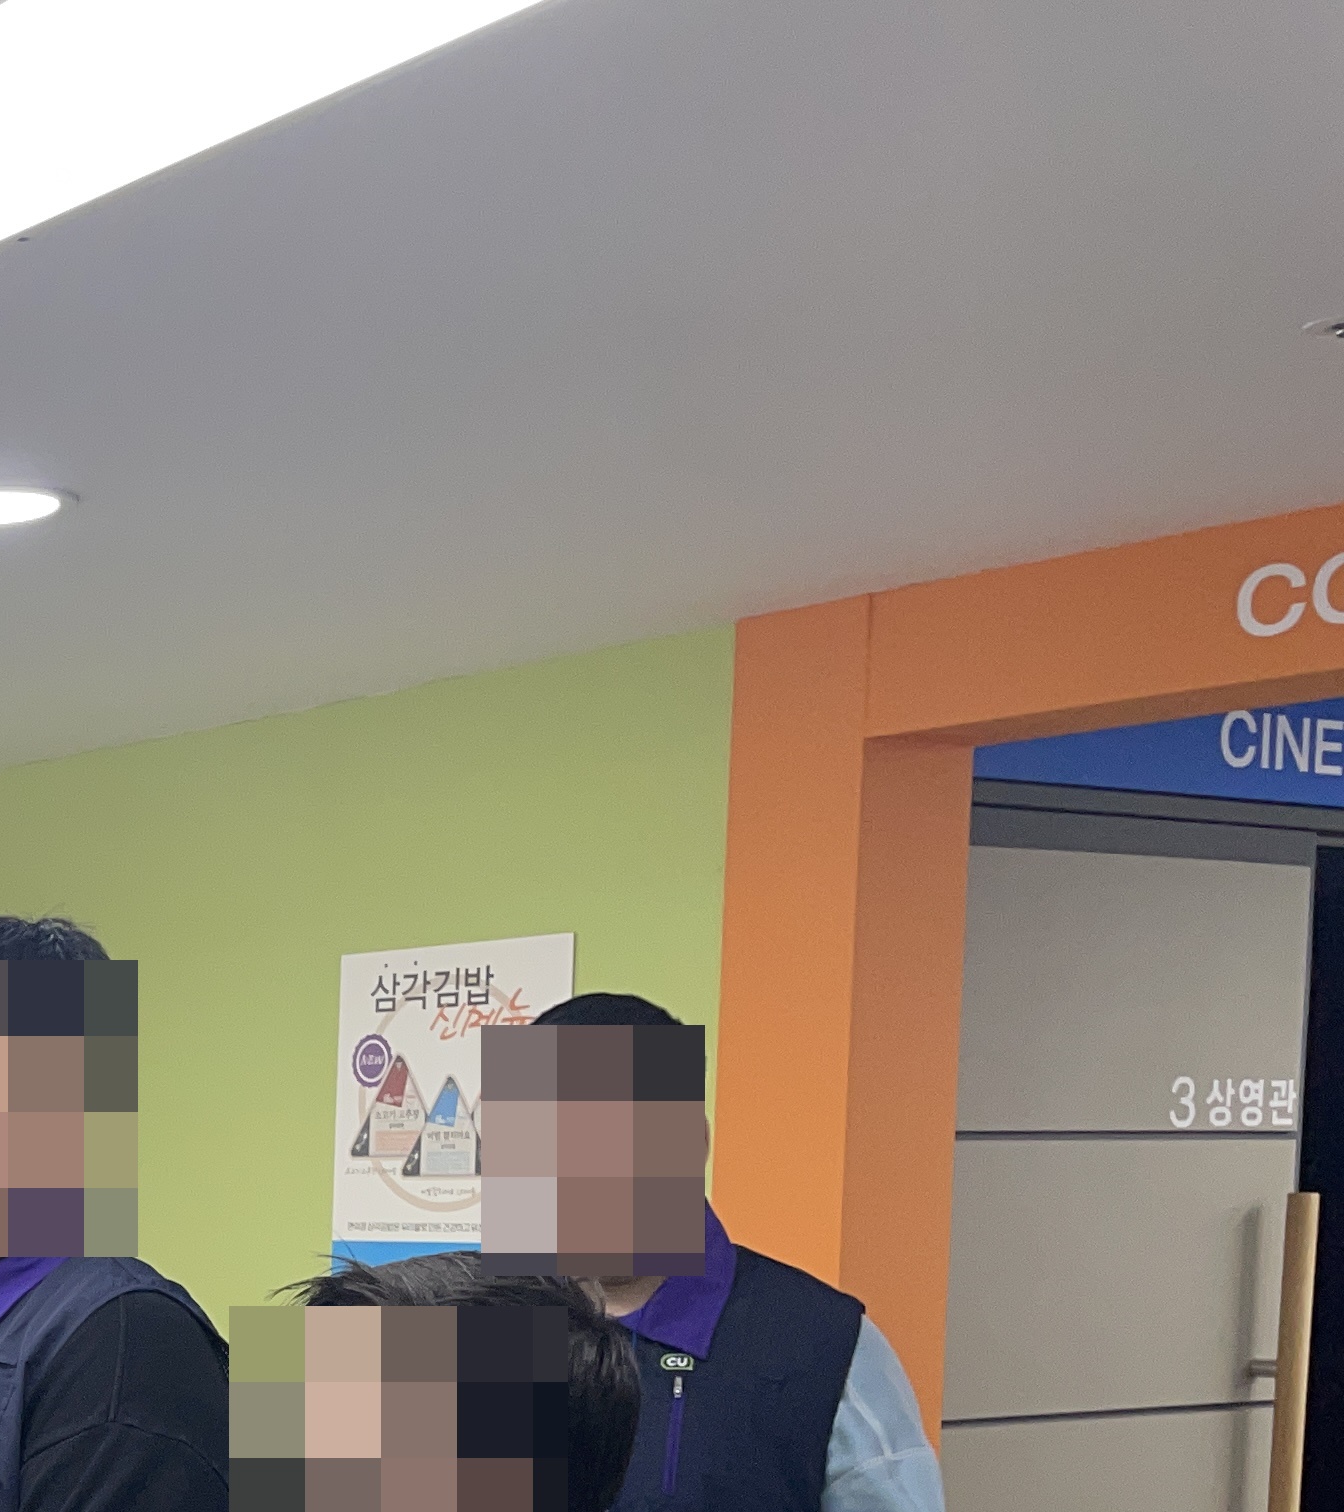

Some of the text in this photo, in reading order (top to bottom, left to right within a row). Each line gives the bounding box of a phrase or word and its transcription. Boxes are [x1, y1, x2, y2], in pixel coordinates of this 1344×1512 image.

[1221, 709, 1344, 777] CINE
[370, 964, 495, 1013] 삼각김밥
[1169, 1076, 1297, 1128] 3 상영관
[664, 1356, 689, 1368] CU
